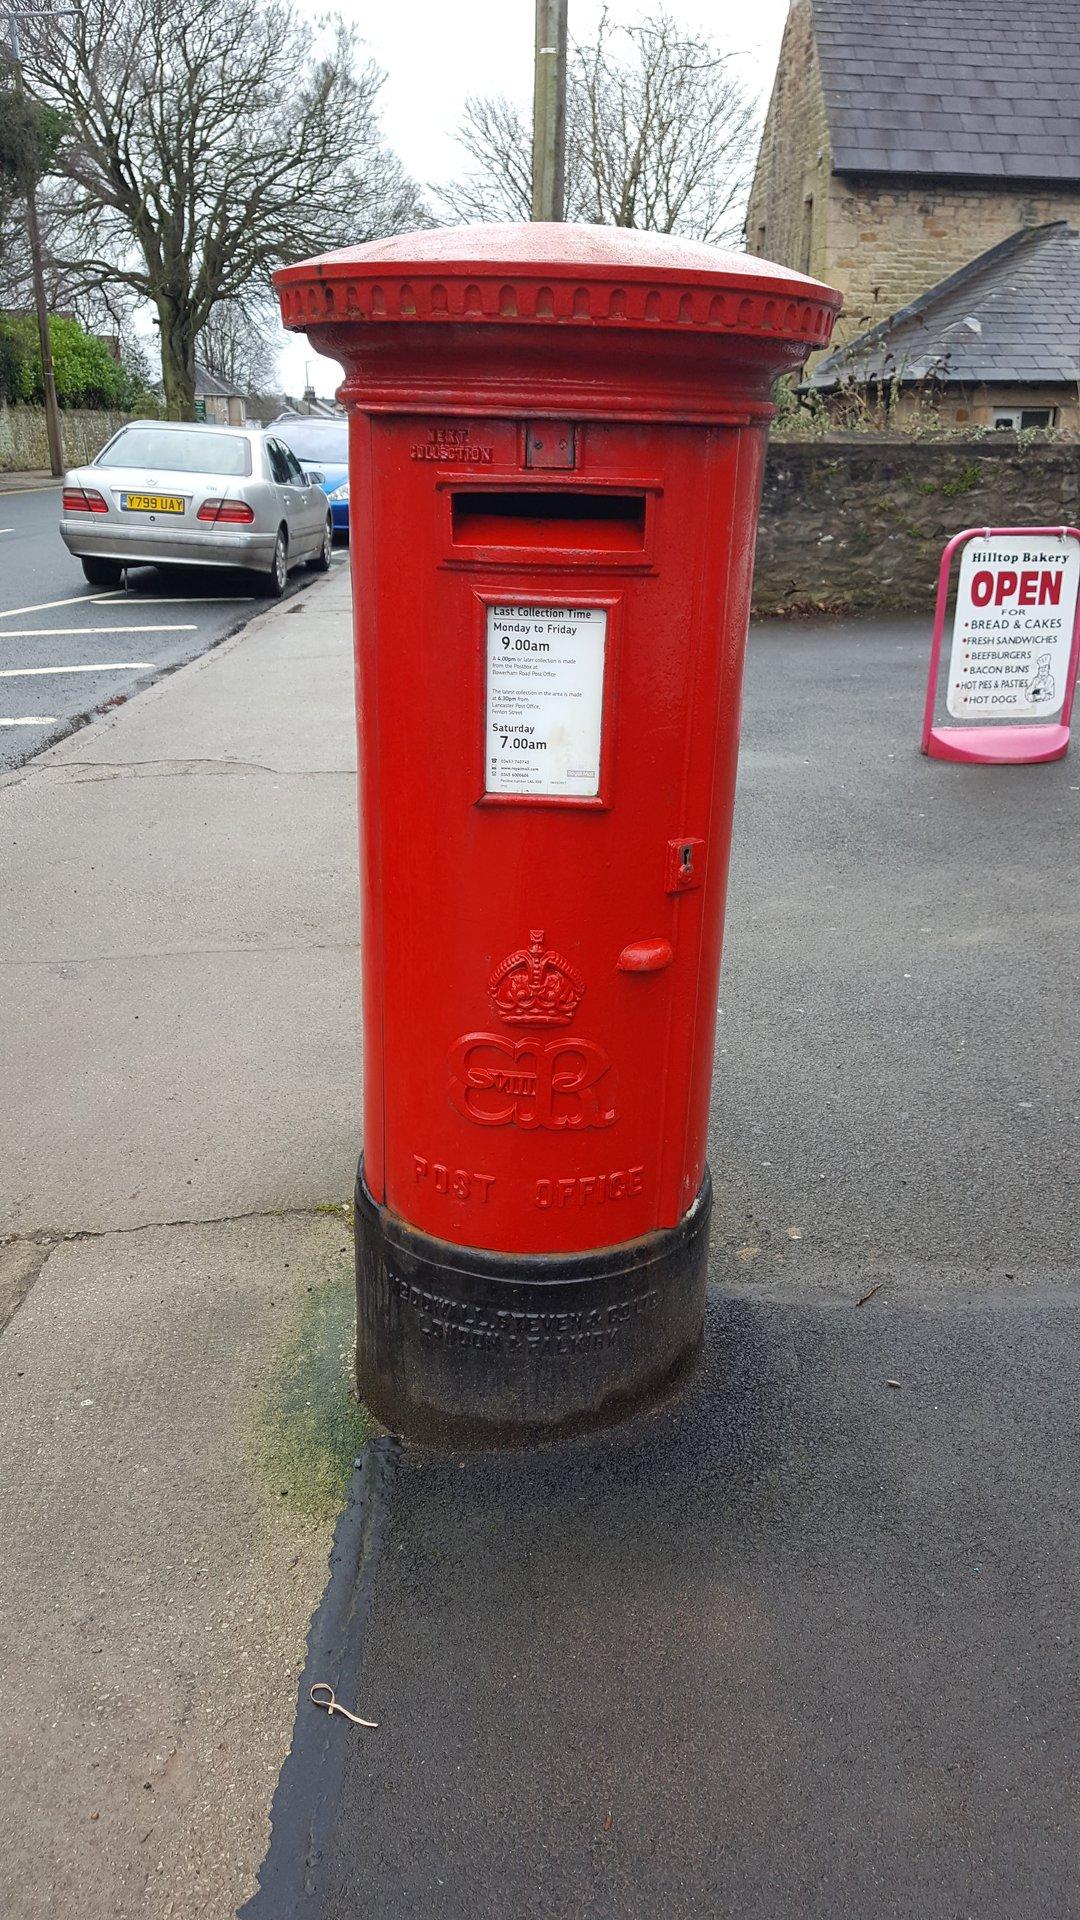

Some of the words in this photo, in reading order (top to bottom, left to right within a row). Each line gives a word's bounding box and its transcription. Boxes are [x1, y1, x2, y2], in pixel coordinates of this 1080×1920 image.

[128, 496, 157, 508] Y799
[161, 499, 182, 510] UAY
[972, 552, 1018, 564] Hilltop
[1023, 552, 1069, 564] Bakery
[971, 570, 1063, 607] OPEN
[493, 606, 515, 616] Last
[517, 607, 564, 618] Collection
[567, 609, 592, 619] Time
[493, 622, 531, 634] Monday
[534, 625, 544, 633] to
[547, 624, 577, 636] Friday
[971, 619, 1009, 629] BREAD
[1013, 619, 1021, 629] &
[1025, 618, 1062, 629] CAKES
[501, 636, 550, 652] 9.00am
[967, 636, 995, 645] FRESH
[996, 635, 1058, 644] SANDWICHES
[971, 651, 1032, 660] BEEFBURGERS
[969, 665, 1003, 674] BACON
[1004, 665, 1029, 674] BUNS
[960, 680, 977, 690] HOT
[1000, 679, 1029, 688] PASTIES
[969, 695, 989, 704] HOT
[991, 695, 1017, 704] DOGS
[492, 723, 535, 734] Saturday
[499, 735, 547, 750] 7.00am
[413, 1153, 496, 1201] POST
[535, 1165, 645, 1208] OFFICE
